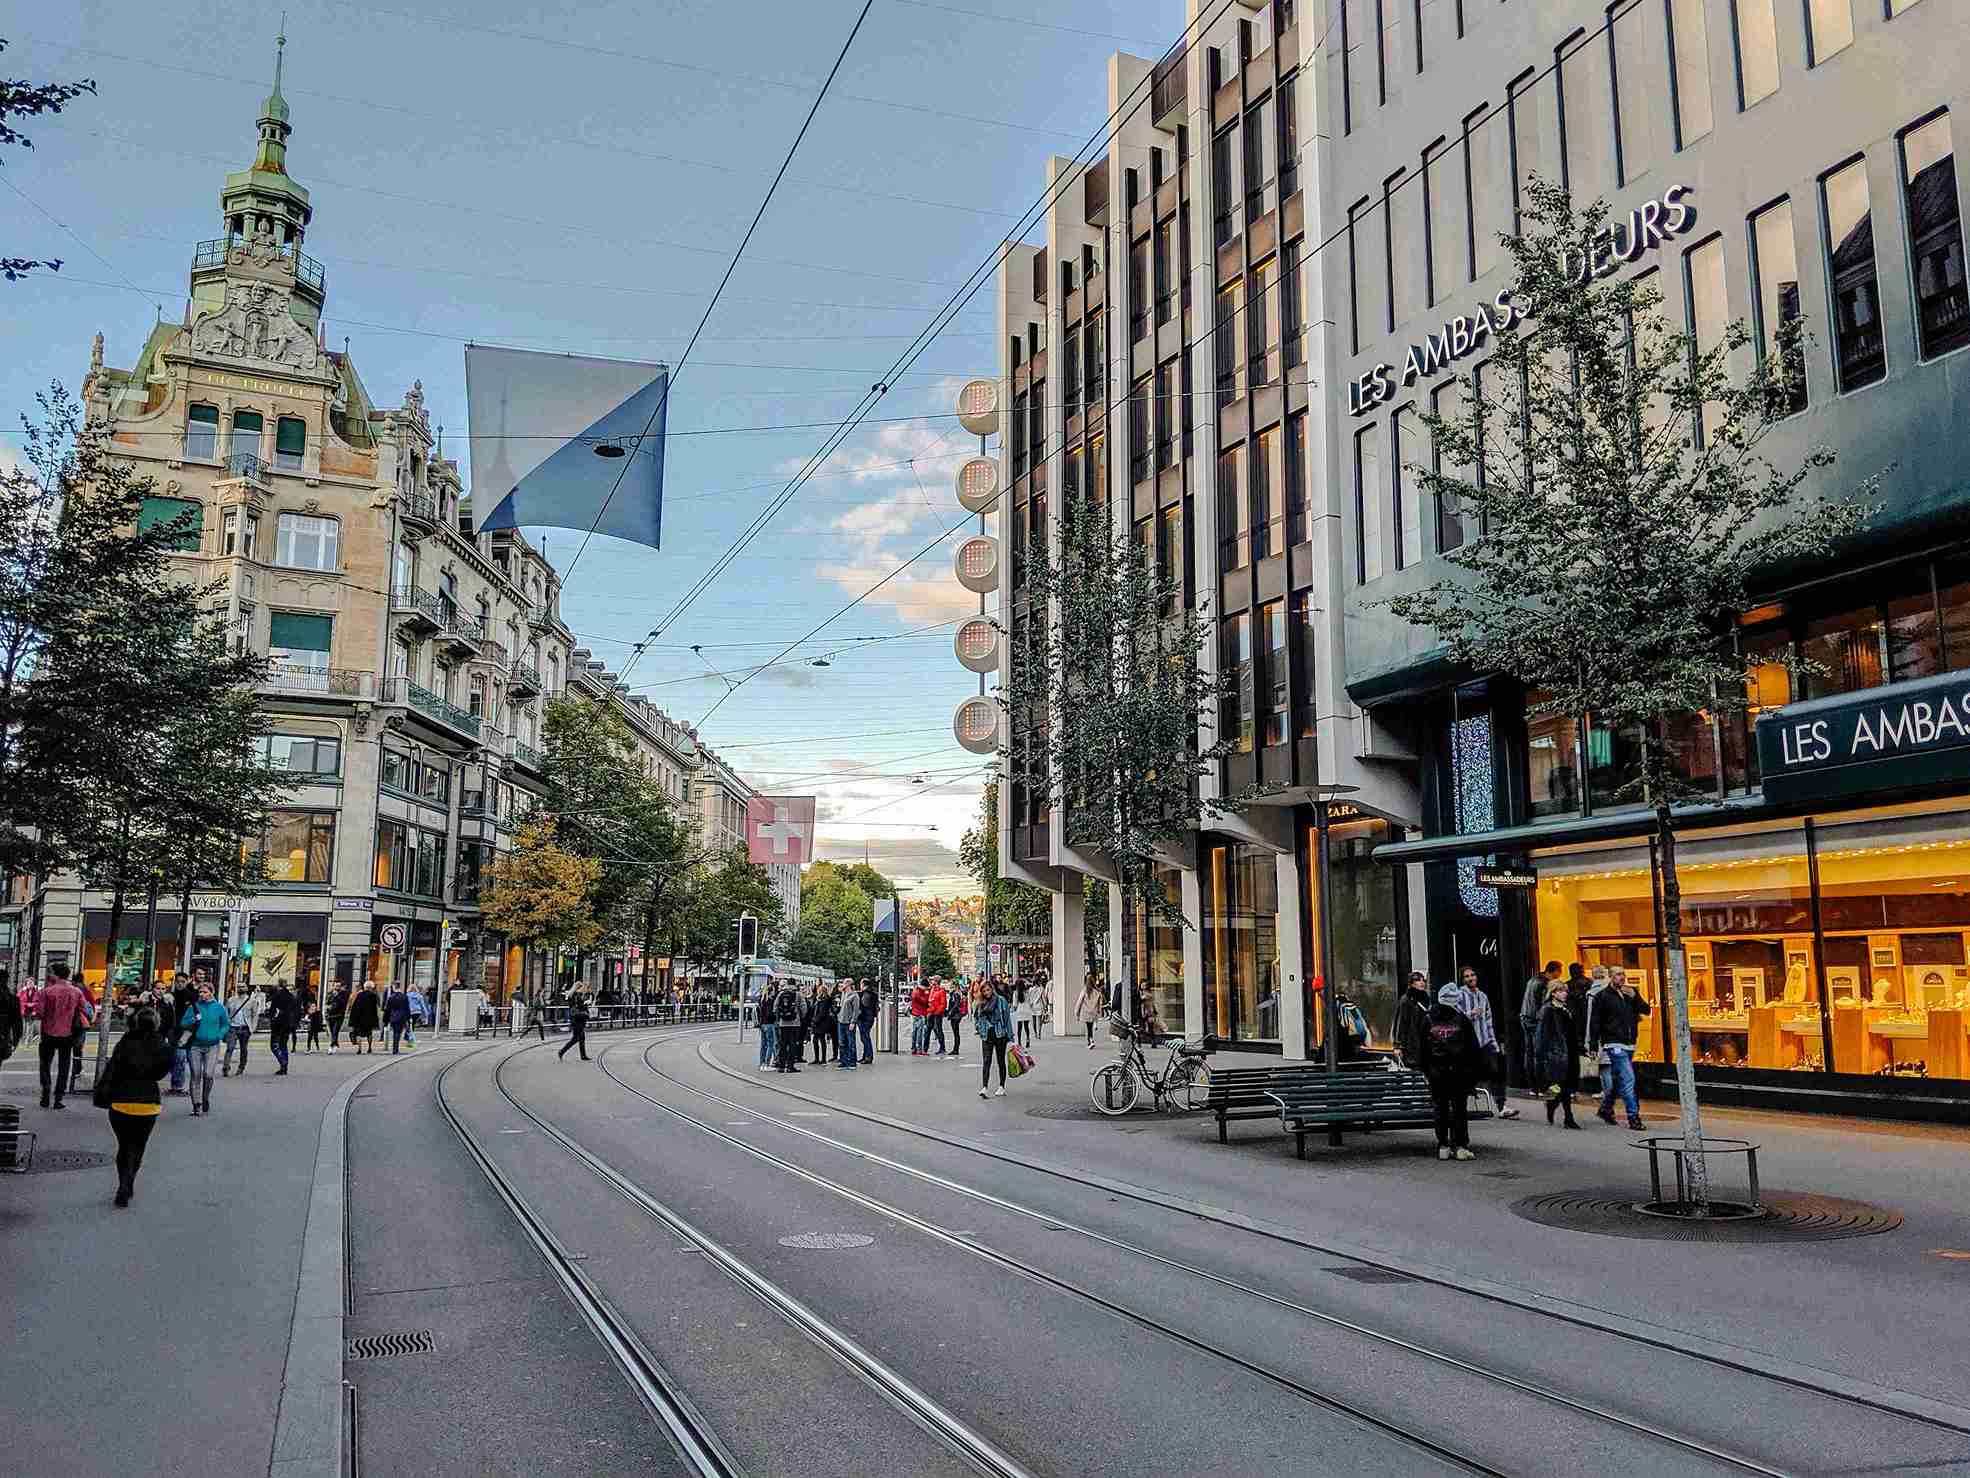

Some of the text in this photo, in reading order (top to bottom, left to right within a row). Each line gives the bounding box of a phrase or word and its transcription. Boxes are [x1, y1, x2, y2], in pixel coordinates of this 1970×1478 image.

[1348, 184, 1695, 416] LES AMBASSDEURS
[1781, 720, 1831, 765] LES
[1327, 804, 1359, 818] ZARA
